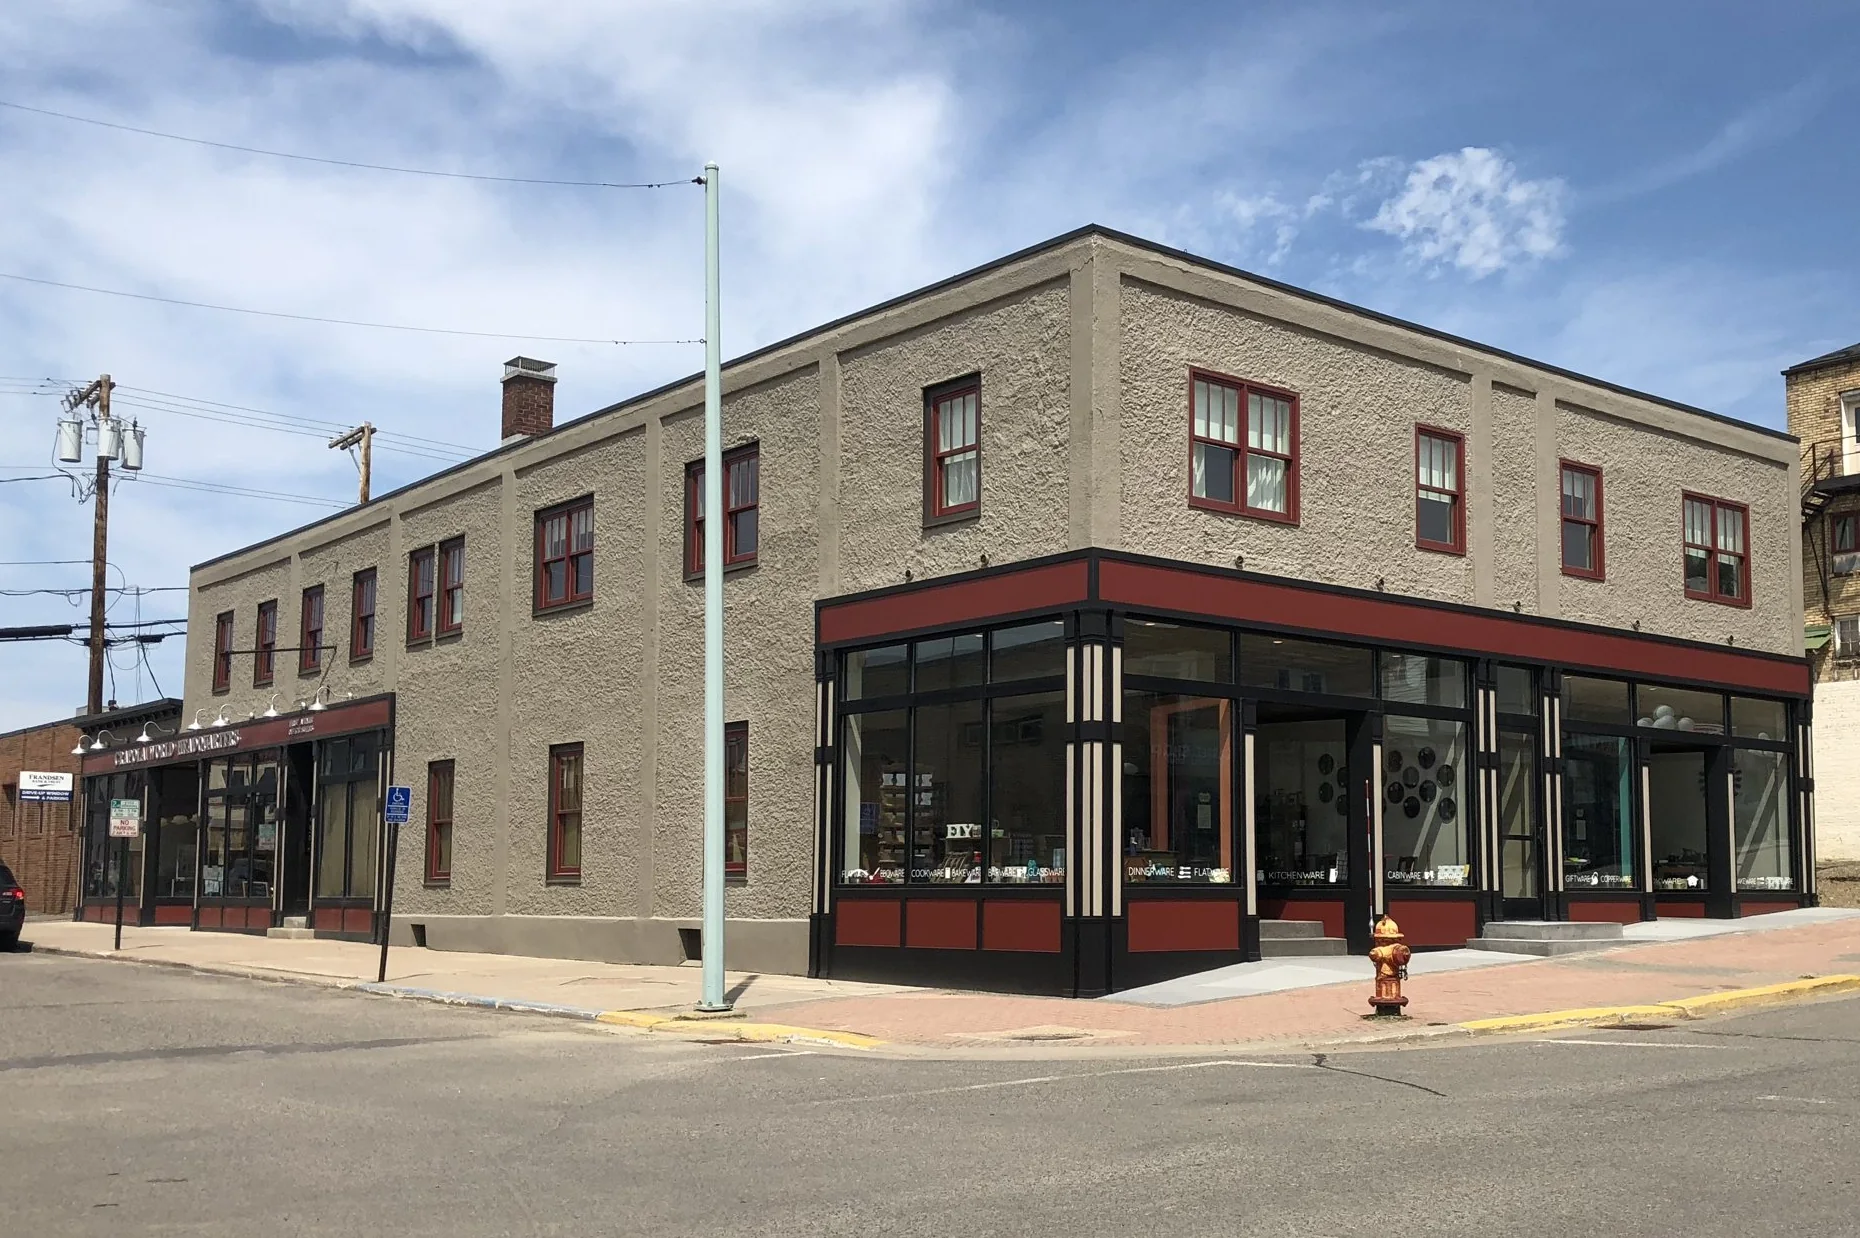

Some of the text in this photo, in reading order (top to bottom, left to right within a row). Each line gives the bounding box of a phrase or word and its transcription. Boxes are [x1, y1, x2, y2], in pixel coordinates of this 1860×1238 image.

[177, 729, 242, 756] HEADQUARTERS
[911, 867, 981, 878] COOKWARE BAKEWAR
[1128, 866, 1175, 877] DINNERWARE
[1268, 870, 1325, 880] KITCHENWARE
[1565, 874, 1632, 883] GIFTWARE COPPERWARE
